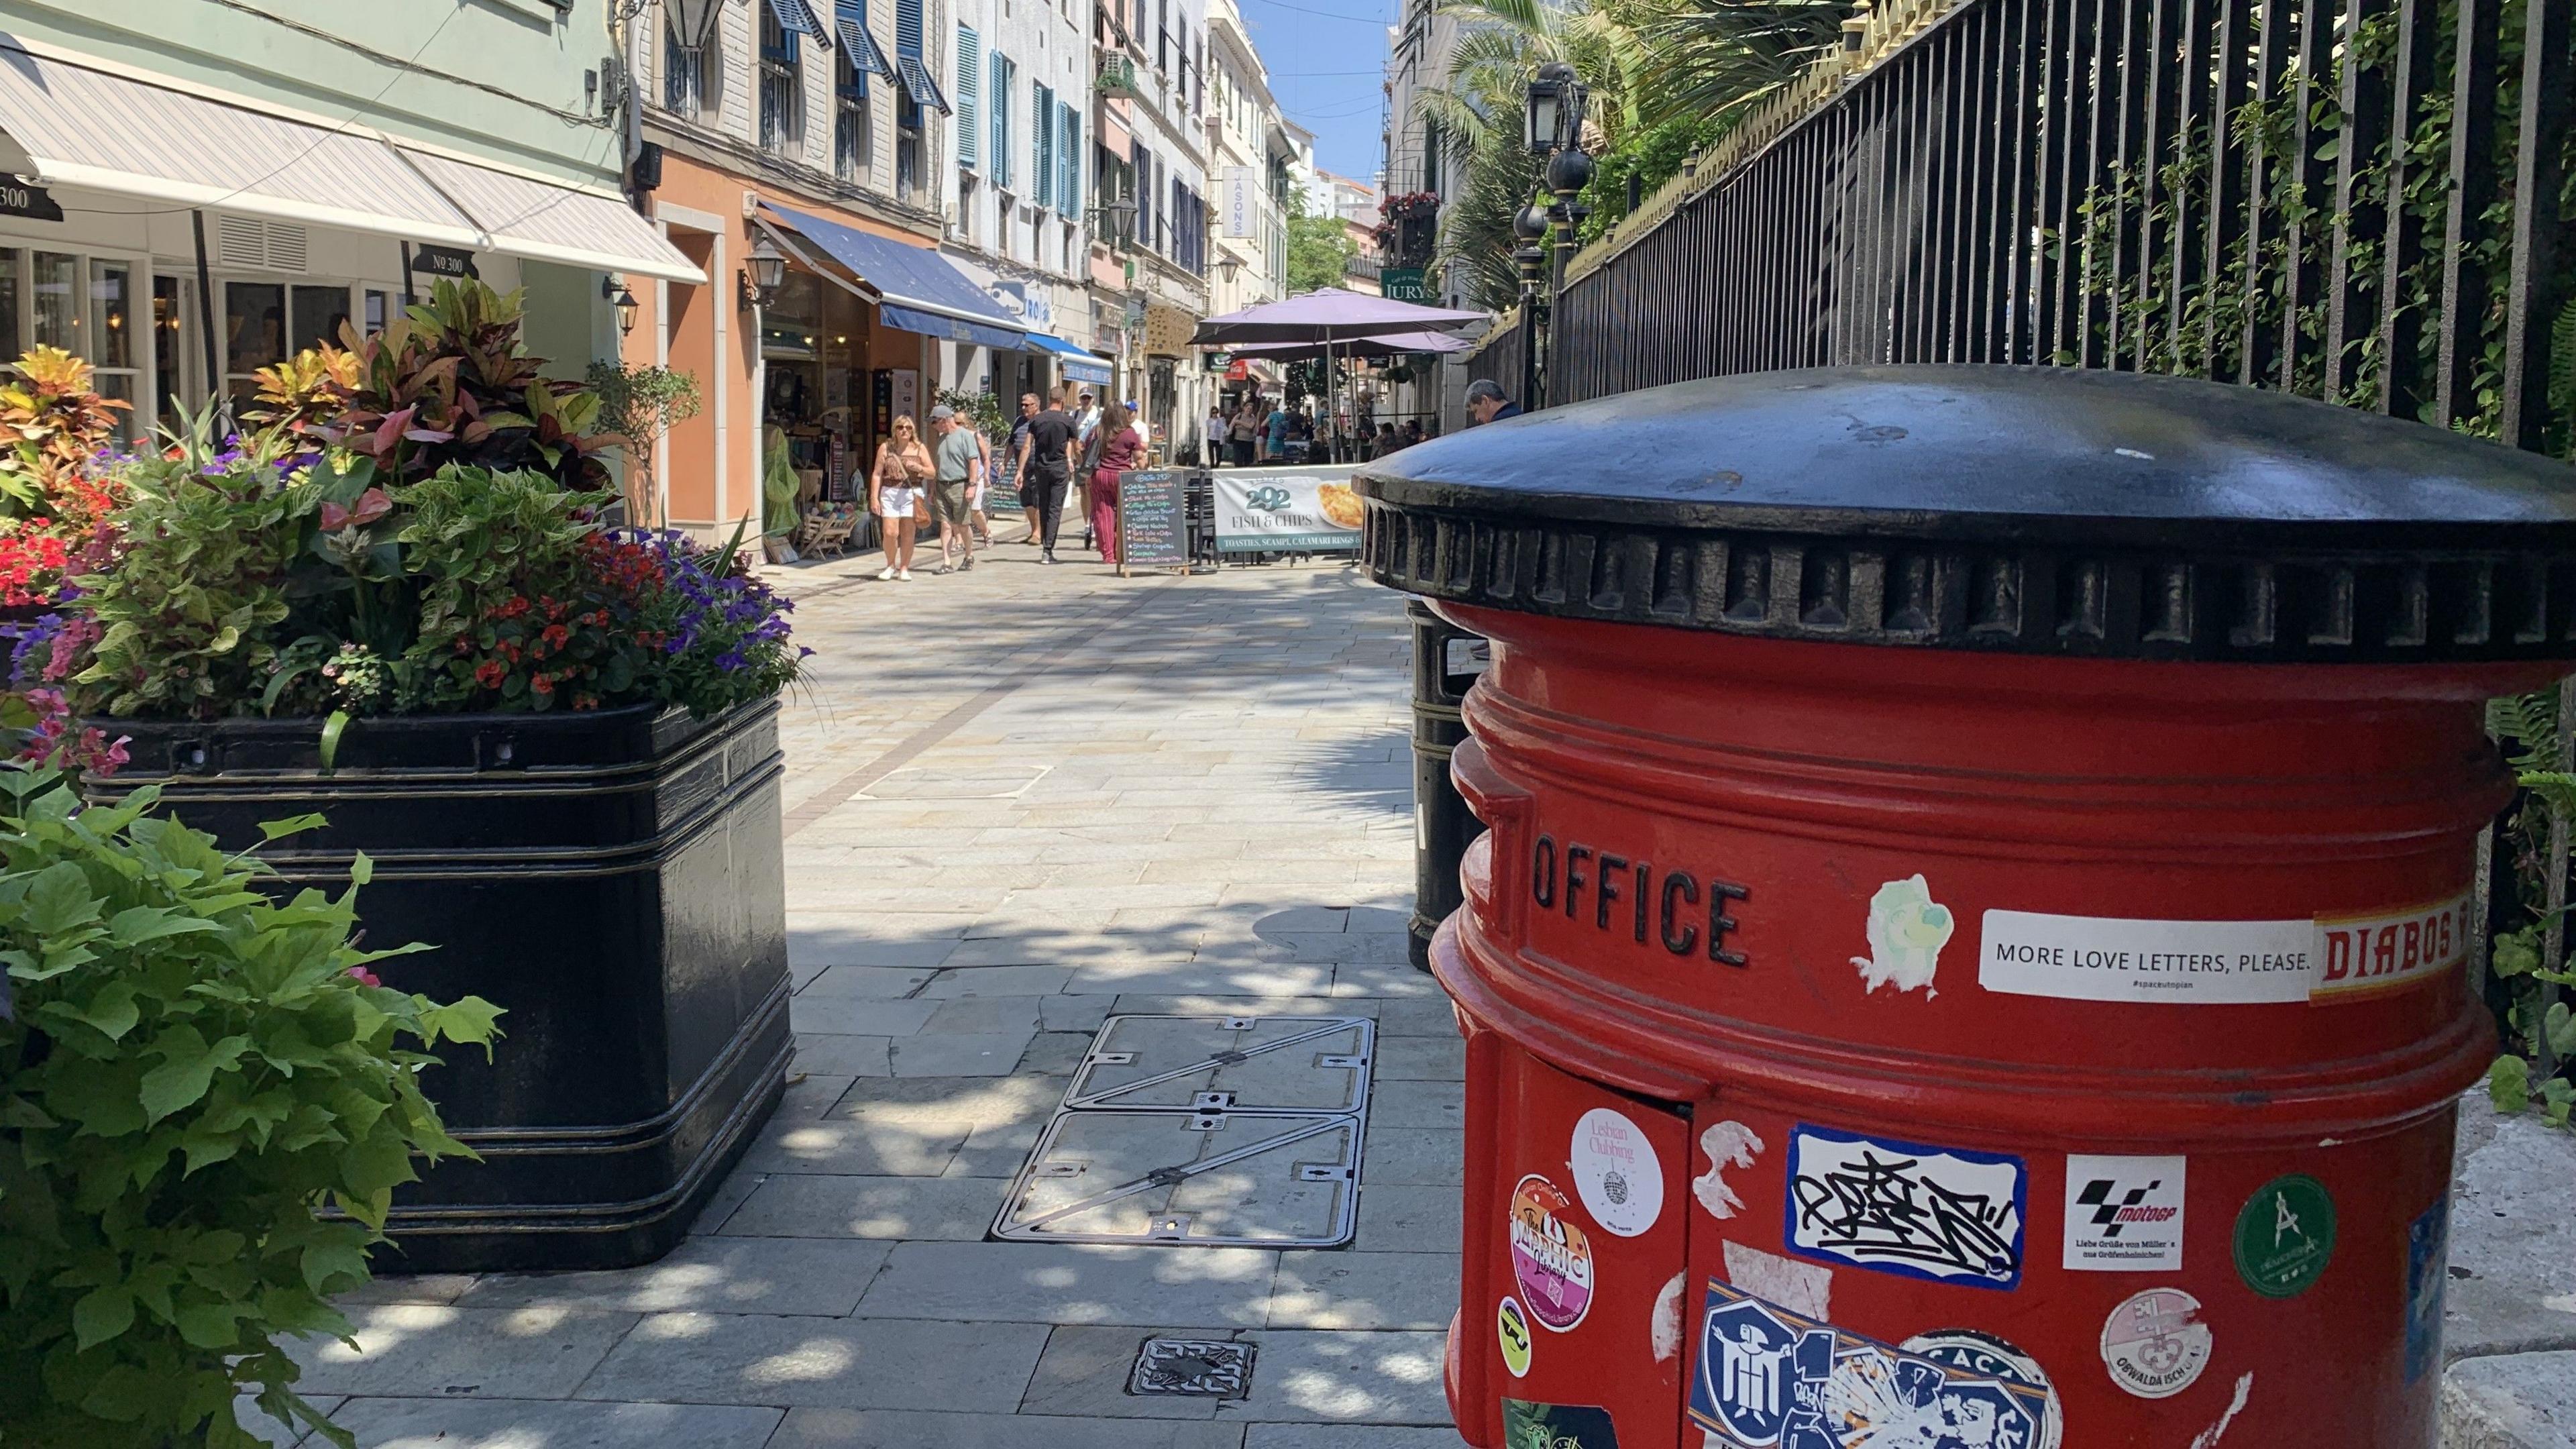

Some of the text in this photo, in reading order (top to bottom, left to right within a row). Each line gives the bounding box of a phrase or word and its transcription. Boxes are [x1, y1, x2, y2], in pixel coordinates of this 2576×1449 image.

[0, 186, 28, 209] 300
[1234, 174, 1243, 231] JASONS
[447, 257, 462, 273] 300
[1246, 486, 1291, 511] 292
[1232, 515, 1312, 528] FISH & CHIPS
[1262, 537, 1291, 547] SCAMPI,
[1292, 536, 1331, 546] CALAMARI
[1332, 536, 1354, 544] RINGS
[1534, 834, 1750, 967] OFFICE
[1996, 943, 2311, 975] MORE LOVE LETTERS, PLEASE.
[1592, 1118, 1627, 1140] Lesbian
[1589, 1136, 1635, 1164] Clubbing
[1523, 1208, 1540, 1234] The
[1515, 1217, 1584, 1279] SAPPHIC
[1534, 1249, 1566, 1286] Library
